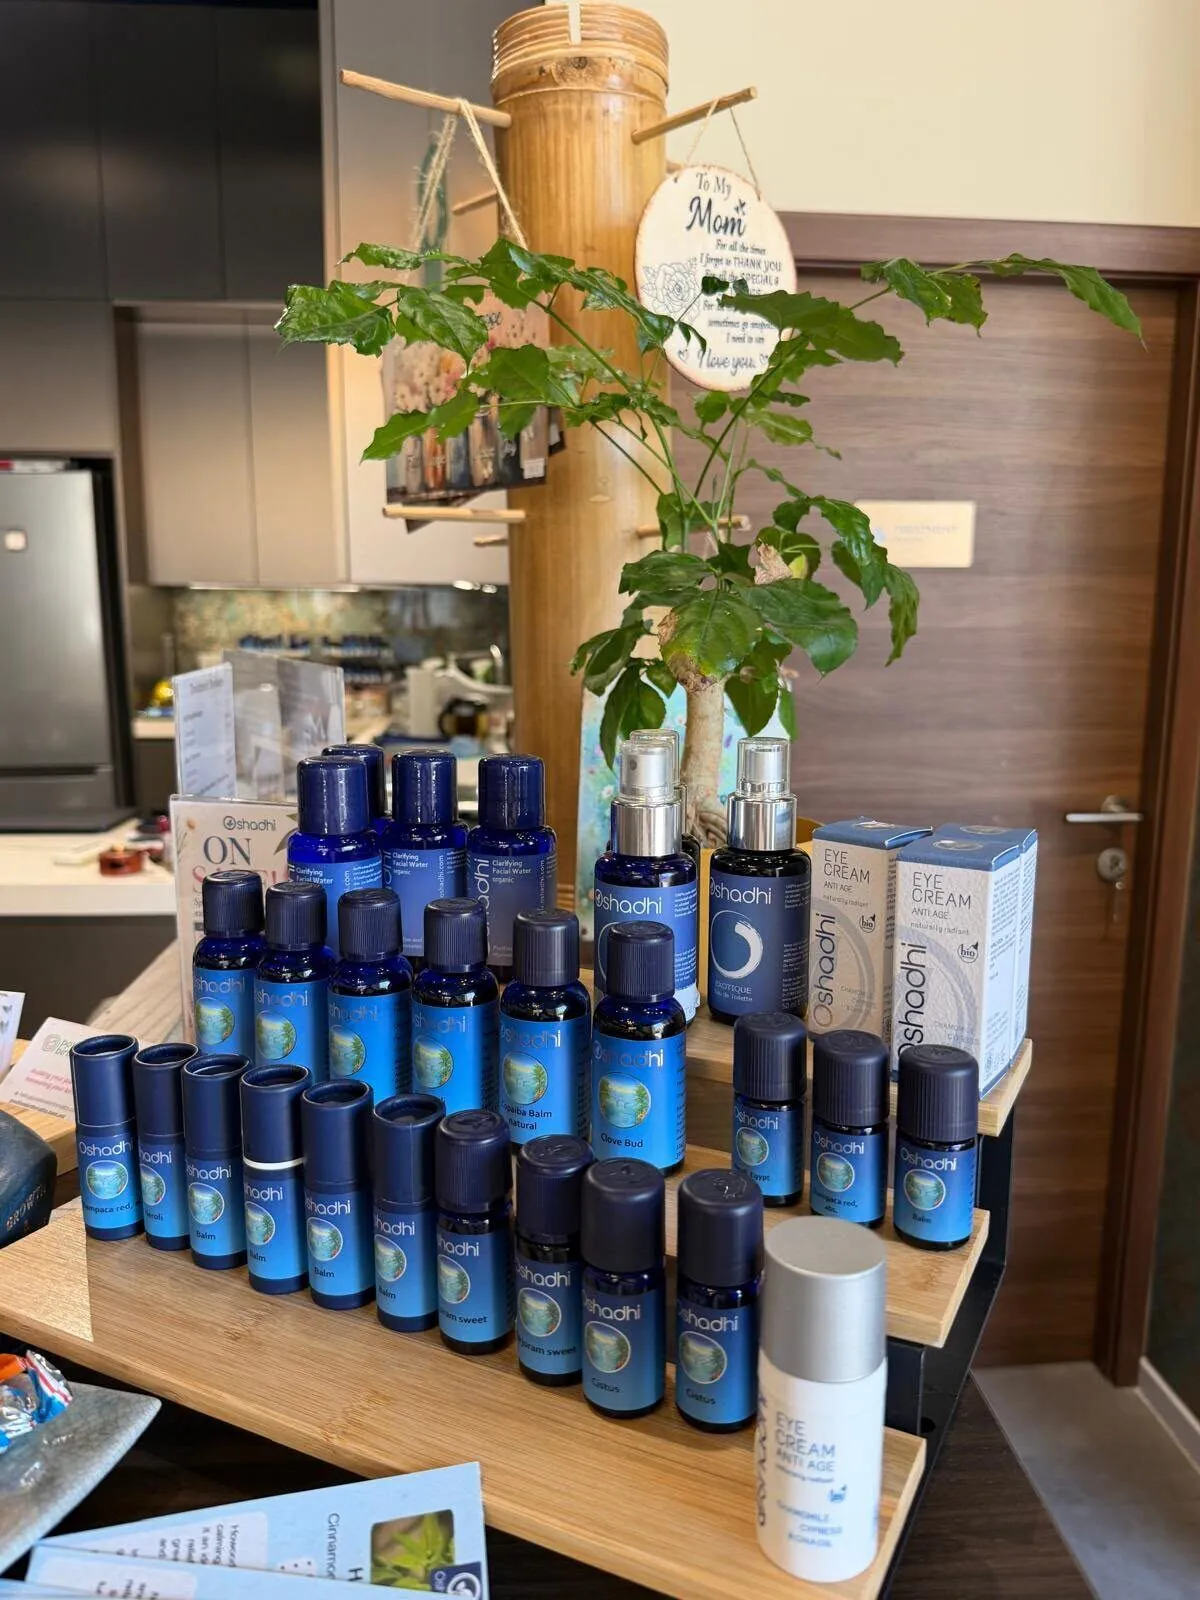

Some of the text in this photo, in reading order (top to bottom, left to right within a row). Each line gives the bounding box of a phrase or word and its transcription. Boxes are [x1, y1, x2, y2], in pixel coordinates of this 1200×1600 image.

[695, 171, 732, 201] To My
[685, 195, 747, 237] Mom
[733, 256, 762, 270] THANK
[706, 347, 730, 369] love
[222, 815, 277, 832] Oshadhi
[203, 835, 253, 866] ON
[391, 851, 420, 862] Clarifying
[824, 848, 849, 866] EYE
[409, 860, 429, 869] Water
[491, 859, 524, 868] Clarifying
[492, 867, 533, 876] Facial Water
[313, 875, 334, 885] Water
[823, 862, 871, 885] CREAM
[912, 871, 944, 890] EYE
[709, 875, 773, 905] Oshadhi
[823, 880, 854, 894] ANTI AGE
[594, 887, 663, 915] Oshadhi
[911, 887, 972, 910] CREAM
[911, 907, 950, 920] ANTI AGE
[813, 911, 836, 1028] Oshadhi
[256, 987, 309, 1008] shadhi
[527, 1108, 553, 1119] Balm
[624, 1137, 644, 1149] Bud
[900, 1146, 958, 1172] Oshadhi
[186, 1164, 232, 1181] shadhi
[304, 1197, 352, 1216] shadhi
[458, 1315, 489, 1325] sweet
[546, 1345, 577, 1357] sweet
[775, 1411, 806, 1437] EYE
[774, 1428, 836, 1458] CREAM
[775, 1448, 803, 1467] ANTI
[807, 1460, 836, 1473] AGE
[348, 1566, 364, 1582] H
